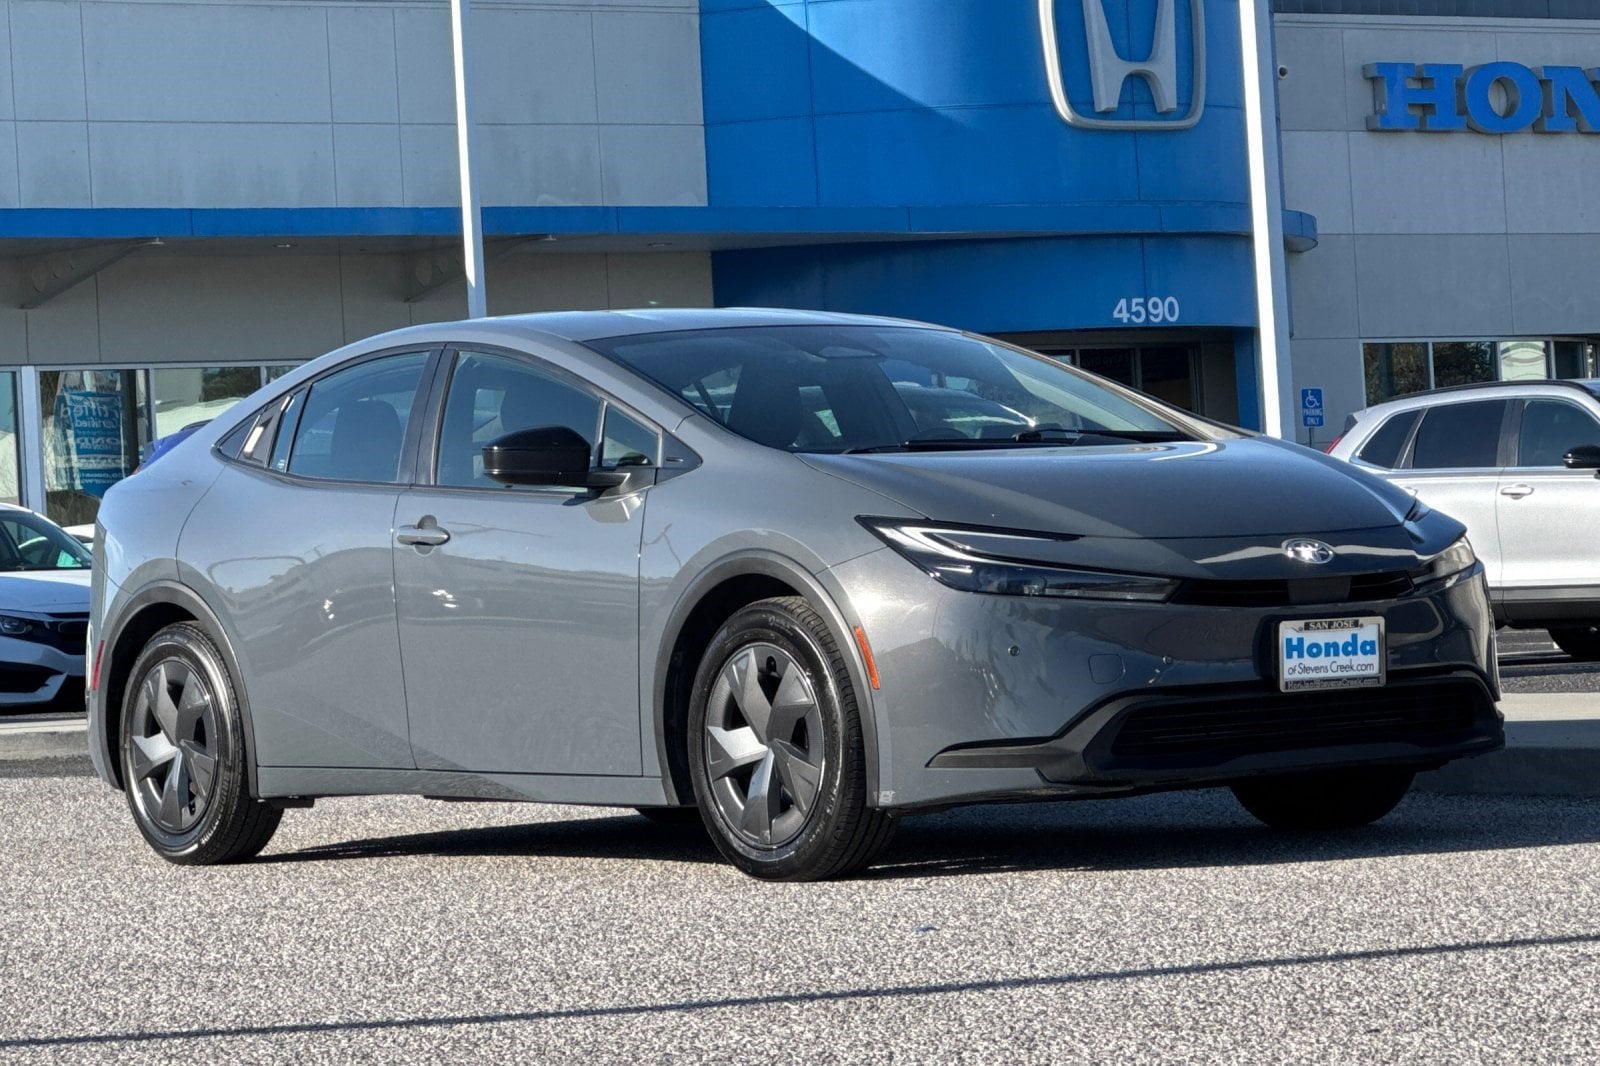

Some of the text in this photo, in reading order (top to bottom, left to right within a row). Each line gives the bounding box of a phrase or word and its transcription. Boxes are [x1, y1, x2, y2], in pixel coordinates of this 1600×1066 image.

[1113, 296, 1179, 323] 4590
[1303, 408, 1323, 416] PARKING
[1307, 417, 1320, 425] ONLY
[1309, 620, 1355, 630] SAN JOSE
[1285, 633, 1376, 659] Honda
[1287, 659, 1375, 676] of Stevens Creek.com
